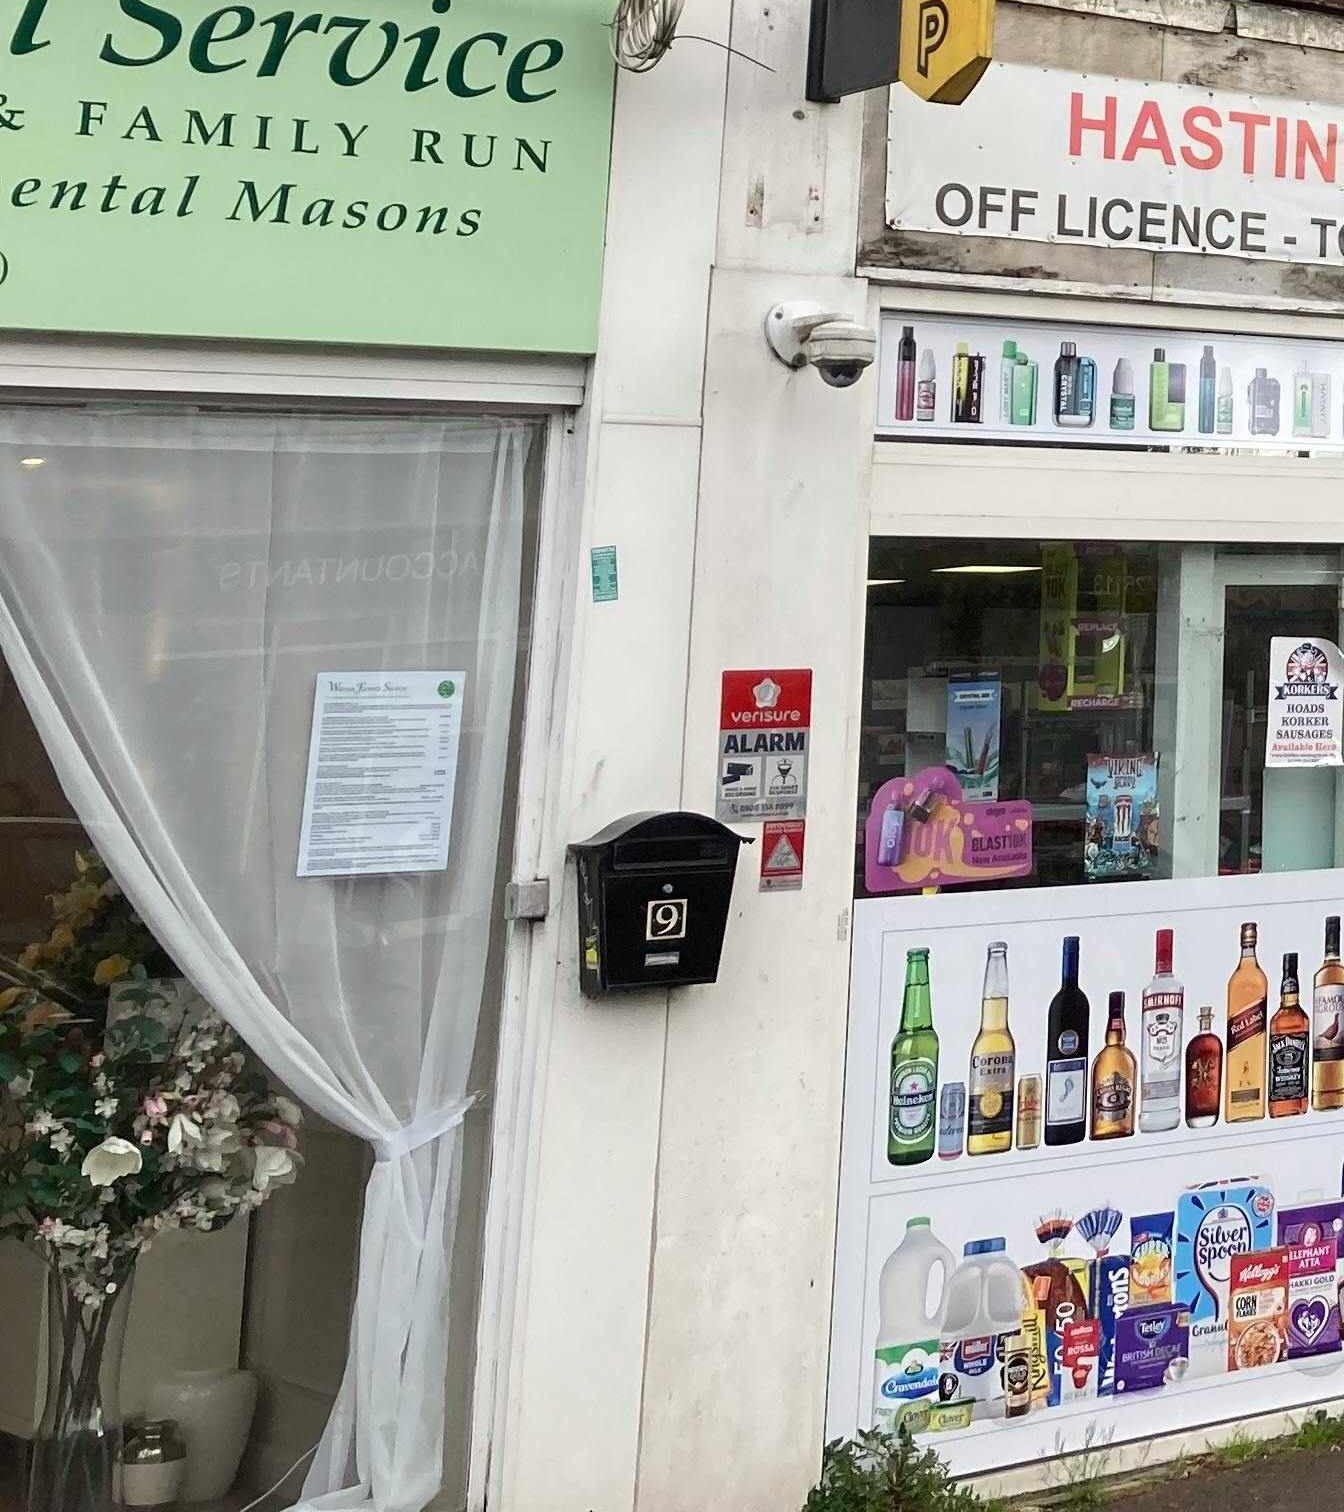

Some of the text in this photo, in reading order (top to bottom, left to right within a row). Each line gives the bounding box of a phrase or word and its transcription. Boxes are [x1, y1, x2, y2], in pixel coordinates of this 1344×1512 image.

[75, 100, 372, 158] FAMILY
[410, 128, 554, 174] RUN
[225, 180, 483, 237] Masons
[934, 181, 1039, 233] OFF
[1056, 192, 1268, 255] LICENCE
[1284, 684, 1331, 695] KORKERS
[1071, 697, 1121, 708] RECHARGE
[1287, 703, 1325, 714] HOADS
[731, 709, 801, 723] verisure
[1281, 716, 1329, 727] KORKER
[1276, 729, 1333, 739] SAUSAGES
[724, 732, 806, 754] ALARM
[1272, 743, 1313, 751] Available
[1105, 756, 1146, 778] VIKING
[655, 904, 679, 935] 9
[1231, 1022, 1245, 1036] Red
[972, 1054, 1014, 1070] Corona
[980, 1067, 1007, 1076] Extra
[893, 1090, 935, 1106] Heineken
[1199, 1225, 1248, 1247] Silver
[1289, 1244, 1331, 1261] ELEPHANT
[1298, 1257, 1321, 1269] ATTA
[1239, 1263, 1281, 1283] Kellogg's
[1313, 1274, 1335, 1286] GOLD
[1235, 1295, 1257, 1311] CORN
[1236, 1309, 1257, 1319] FLAKES
[1140, 1321, 1165, 1333] Tetley
[1023, 1312, 1047, 1390] Kingsmill
[1067, 1344, 1095, 1356] ROSSA
[1122, 1343, 1181, 1363] BRITISH DECAF
[963, 1359, 988, 1370] WHOLE
[968, 1366, 982, 1376] MILK
[903, 1409, 930, 1426] Clover
[938, 1412, 965, 1425] Clover
